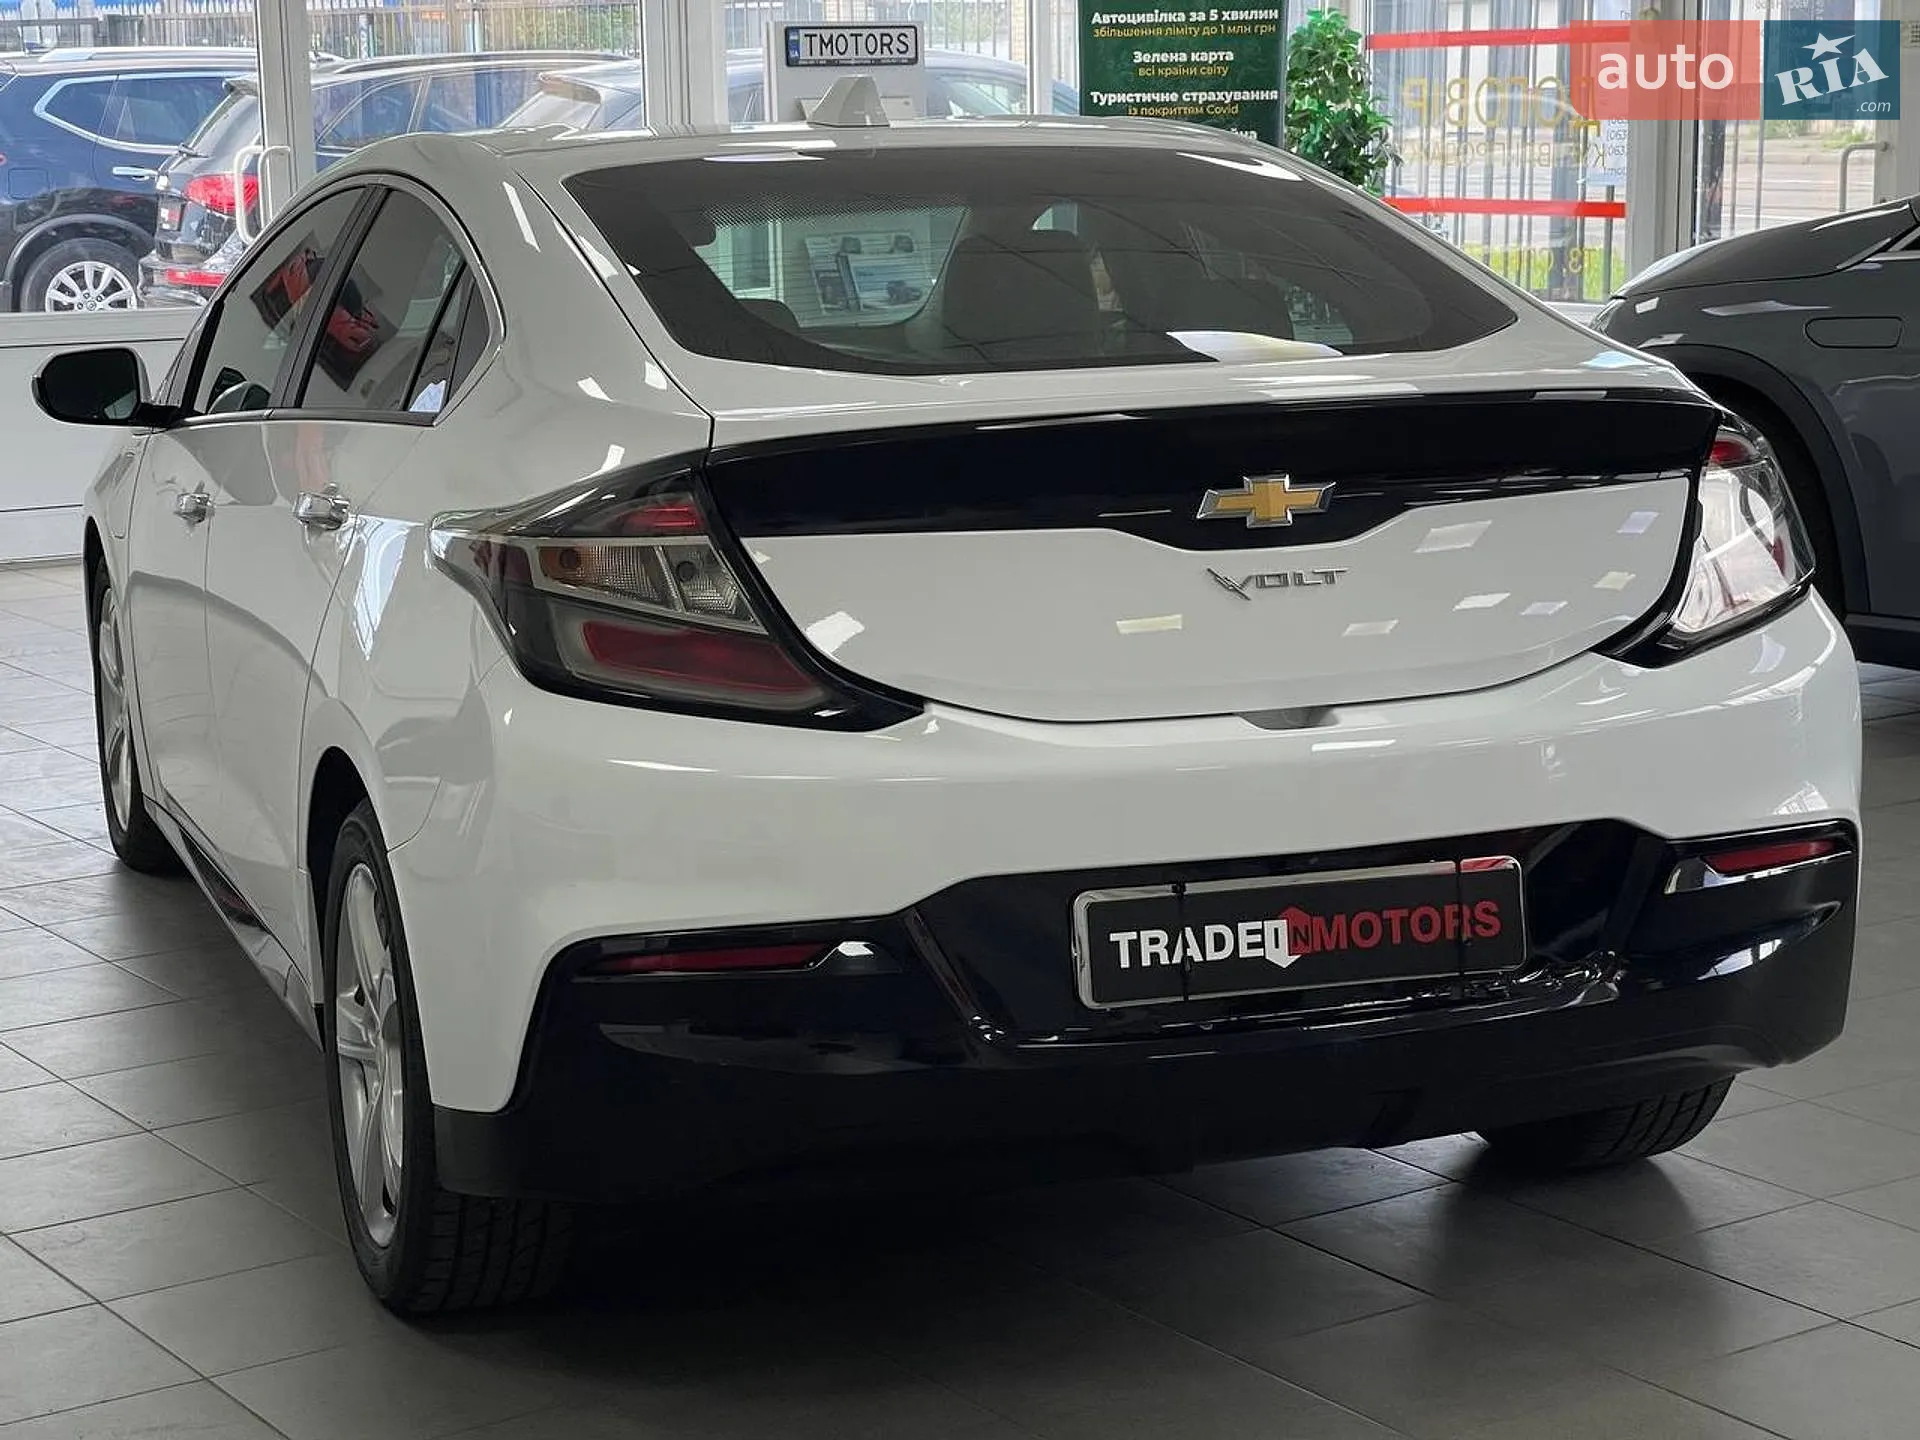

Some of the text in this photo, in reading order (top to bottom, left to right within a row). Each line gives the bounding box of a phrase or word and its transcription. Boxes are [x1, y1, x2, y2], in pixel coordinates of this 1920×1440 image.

[1091, 9, 1279, 25] Автоцивілка за 5 хвилин
[1093, 24, 1277, 38] збільшення ліміту до 1 млн грн
[804, 33, 909, 56] TMOTORS
[1133, 50, 1234, 64] Зелена карта
[1138, 64, 1229, 77] всі країни світу
[1090, 89, 1278, 105] Туристичне страхування
[1206, 104, 1239, 115] Covid
[1207, 567, 1349, 601] VOLT
